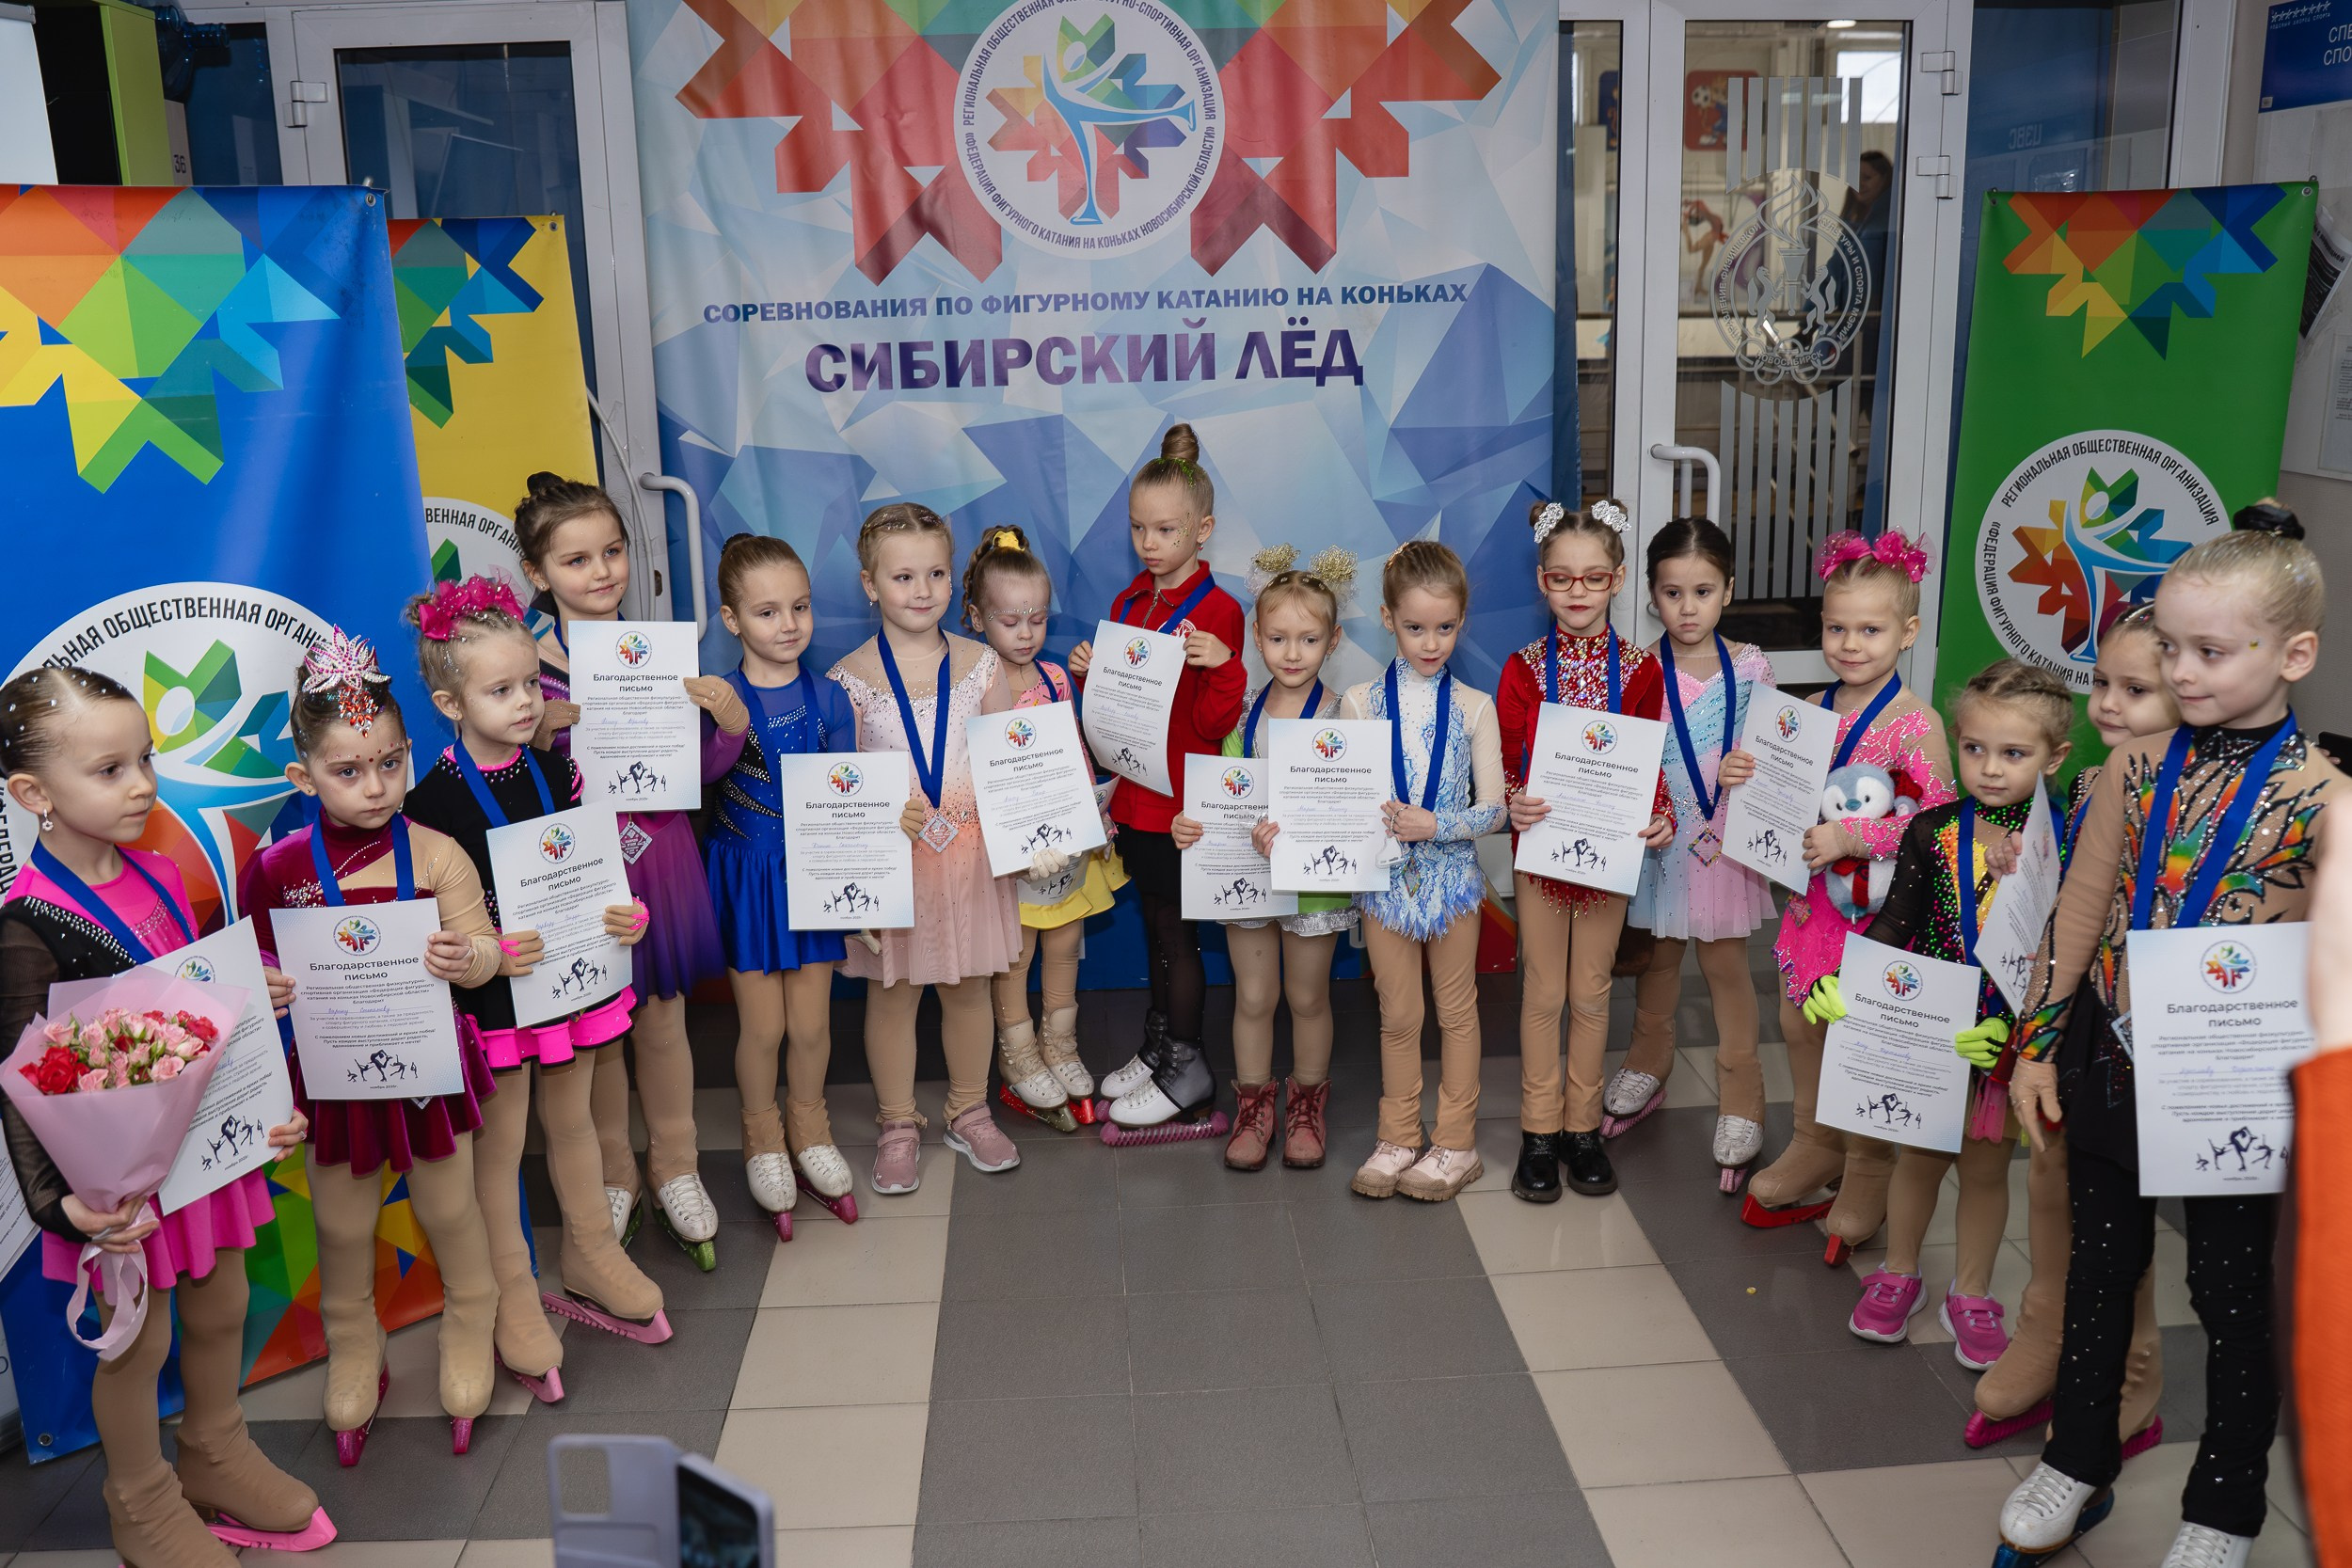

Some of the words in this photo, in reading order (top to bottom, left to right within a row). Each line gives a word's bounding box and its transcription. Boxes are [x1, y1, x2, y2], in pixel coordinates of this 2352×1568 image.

[963, 48, 993, 125] РЕГИОНАЛЬНАЯ
[986, 0, 1055, 51] ОБЩЕСТВЕННАЯ
[1186, 48, 1216, 120] ОРГАНИЗАЦИЯ
[173, 153, 186, 174] 36
[992, 193, 1039, 235] ФИГУРНОГО
[1039, 227, 1080, 248] КАТАНИЯ
[1083, 237, 1095, 249] НА
[1098, 228, 1141, 248] КОНЬКАХ
[1140, 173, 1202, 236] НОВОСИБИРСКОЙ
[1853, 266, 1864, 304] СПОРТА
[703, 297, 927, 324] СОРЕВНОВАНИЯ
[936, 296, 973, 318] ПО
[980, 291, 1150, 315] ФИГУРНОМУ
[1157, 287, 1289, 310] КАТАНИЮ
[1297, 285, 1333, 308] НА
[1341, 282, 1468, 305] КОНЬКАХ
[1836, 308, 1860, 341] МЭРИИ
[805, 317, 1216, 393] СИБИРСКИЙ
[1235, 316, 1363, 387] ЛЁД
[1755, 351, 1823, 367] НОВОСИБИРСК
[2001, 445, 2072, 508] РЕГИОНАЛЬНАЯ
[2073, 438, 2162, 463] ОБЩЕСТВЕННАЯ
[2161, 455, 2219, 526] ОРГАНИЗАЦИЯ
[425, 507, 476, 529] ВЕННАЯ
[103, 595, 262, 639] ОБЩЕСТВЕННАЯ
[1989, 594, 2032, 656] ФИГУРНОГО
[2026, 649, 2074, 681] КАТАНИЯ
[2075, 671, 2090, 685] НА
[593, 673, 678, 683] Благодарственное
[1103, 666, 1163, 687] Благодарственное
[619, 685, 653, 694] письмо
[1118, 680, 1142, 691] письмо
[989, 747, 1064, 768] Благодарственное
[1756, 735, 1814, 767] Благодарственное
[1013, 761, 1043, 772] письмо
[1554, 752, 1639, 773] Благодарственное
[1770, 753, 1794, 768] письмо
[1290, 765, 1372, 774] Благодарственное
[1578, 767, 1613, 779] письмо
[805, 800, 890, 810] Благодарственное
[1200, 800, 1268, 811] Благодарственн
[832, 811, 866, 819] письмо
[1223, 813, 1255, 821] письмо
[520, 858, 604, 888] Благодарственное
[548, 876, 581, 893] письмо
[310, 956, 419, 972] Благодарственное
[344, 971, 389, 981] письмо
[1854, 992, 1950, 1023] Благодарственное
[2167, 998, 2298, 1015] Благодарственное
[1880, 1013, 1920, 1028] письмо
[2208, 1016, 2262, 1029] письмо
